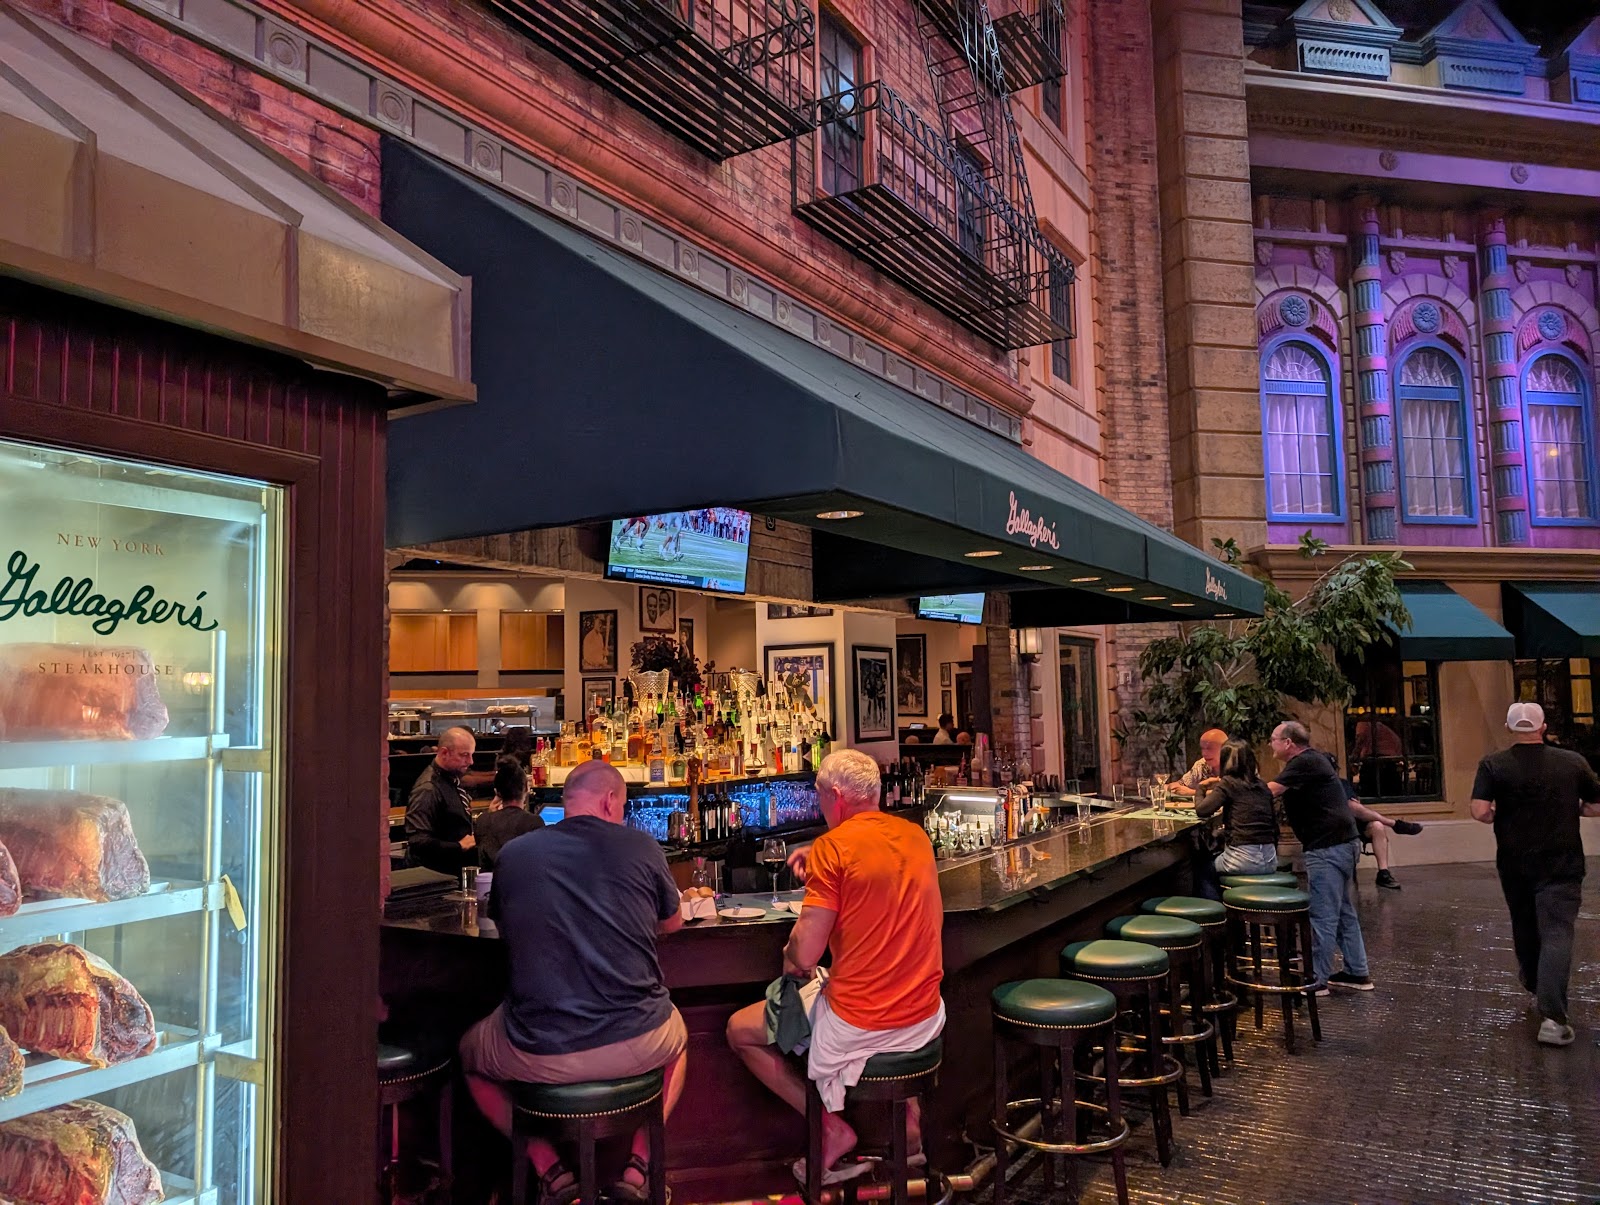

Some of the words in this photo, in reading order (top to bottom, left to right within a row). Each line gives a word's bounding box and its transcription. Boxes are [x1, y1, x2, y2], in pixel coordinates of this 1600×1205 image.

[1006, 490, 1060, 550] Gallagher's
[57, 533, 102, 549] NEW
[112, 539, 164, 556] YORK
[0, 550, 219, 635] Gallagher's
[38, 662, 174, 676] STEAKHOUSE
